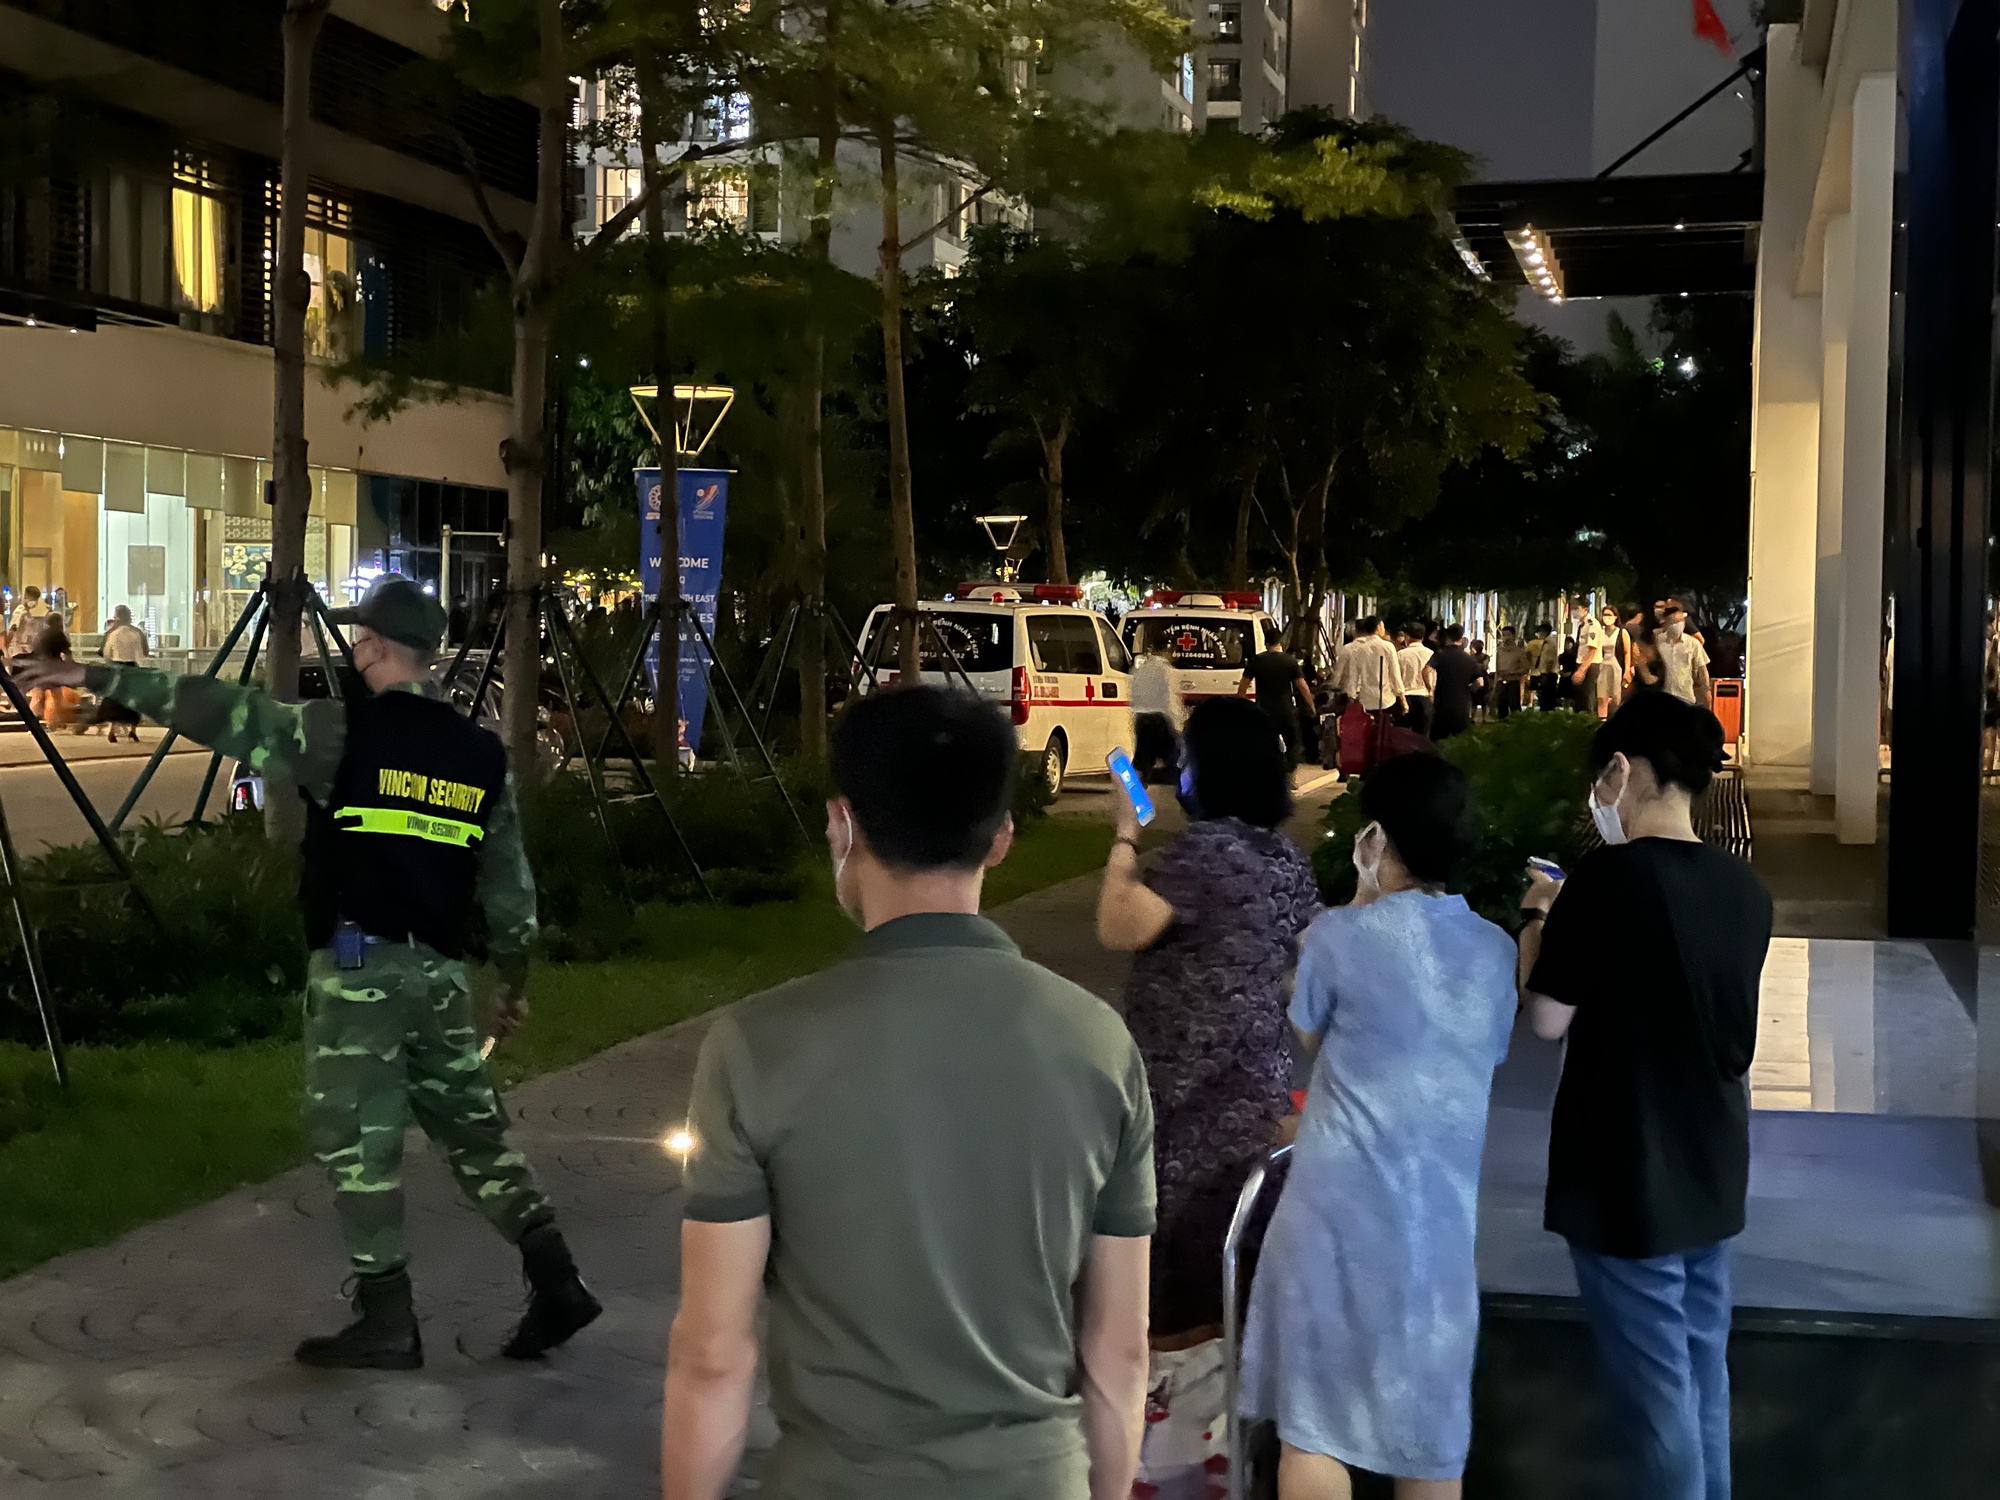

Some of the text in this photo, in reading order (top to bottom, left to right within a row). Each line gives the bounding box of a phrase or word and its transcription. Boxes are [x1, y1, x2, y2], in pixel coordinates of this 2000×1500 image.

[649, 557, 709, 568] WCOME
[645, 594, 658, 602] THE
[695, 594, 715, 603] EAST
[428, 778, 486, 814] SECURITY
